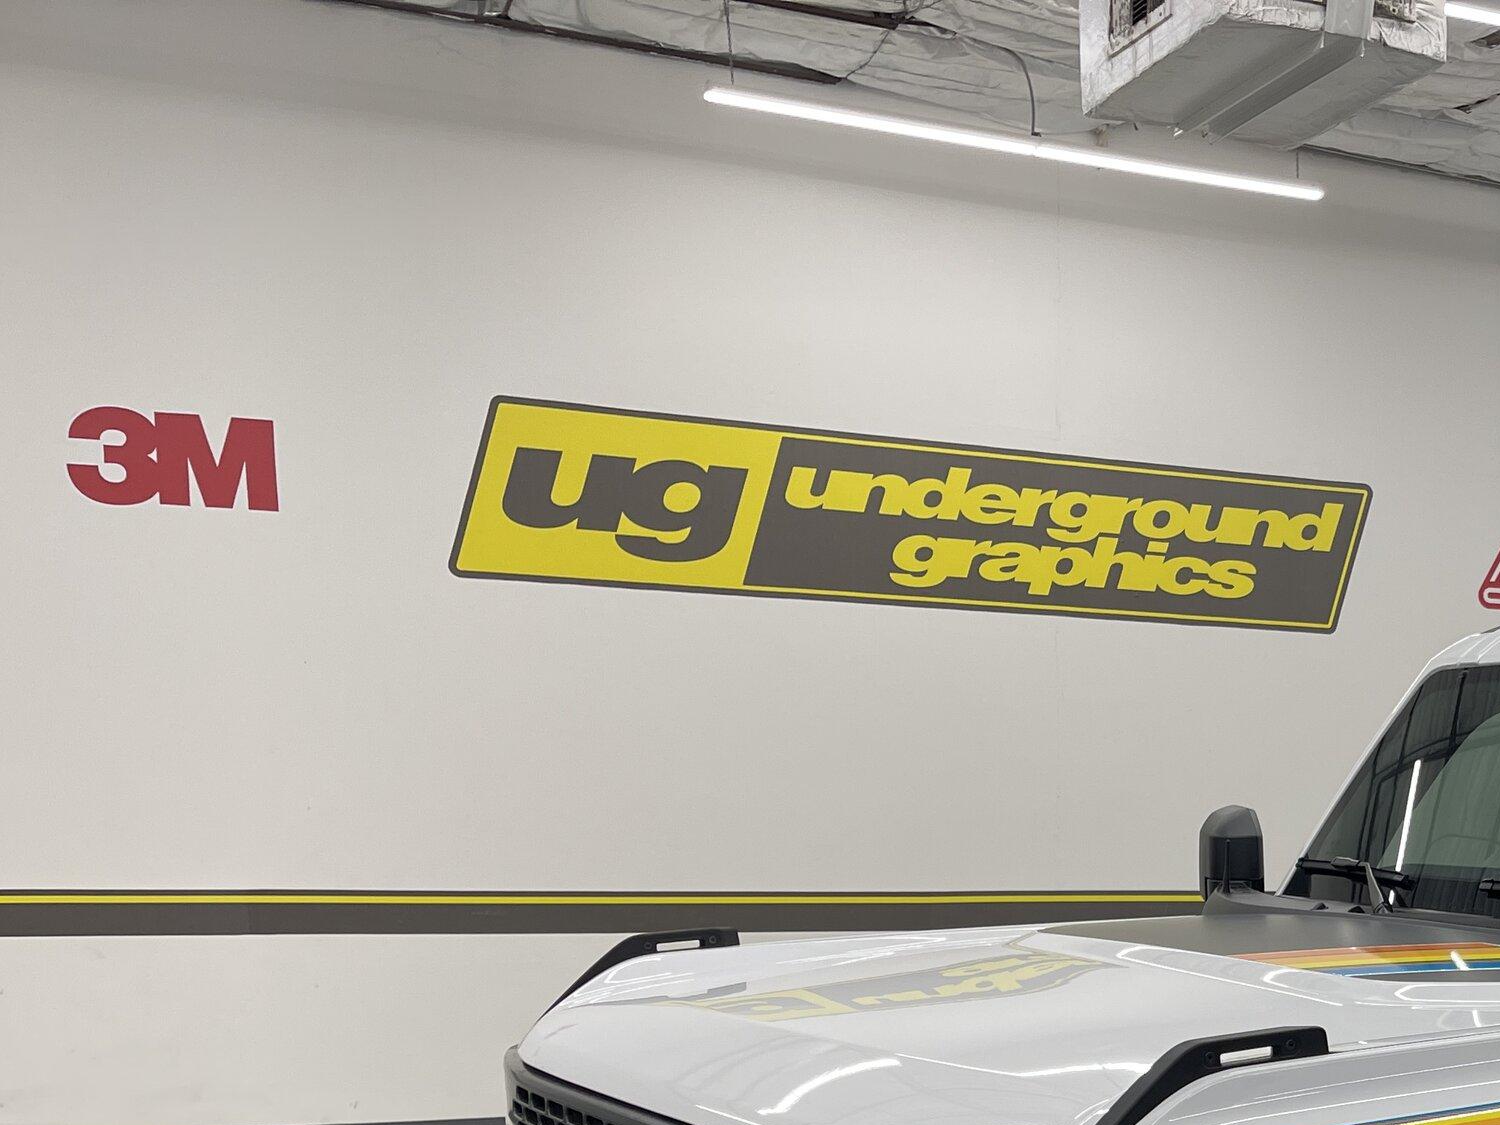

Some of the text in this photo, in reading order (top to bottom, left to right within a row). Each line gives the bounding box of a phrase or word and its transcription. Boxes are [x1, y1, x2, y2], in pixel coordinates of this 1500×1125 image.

[66, 406, 279, 512] 3M
[501, 446, 749, 562] ug
[784, 466, 1344, 552] underground
[889, 533, 1257, 599] graphics
